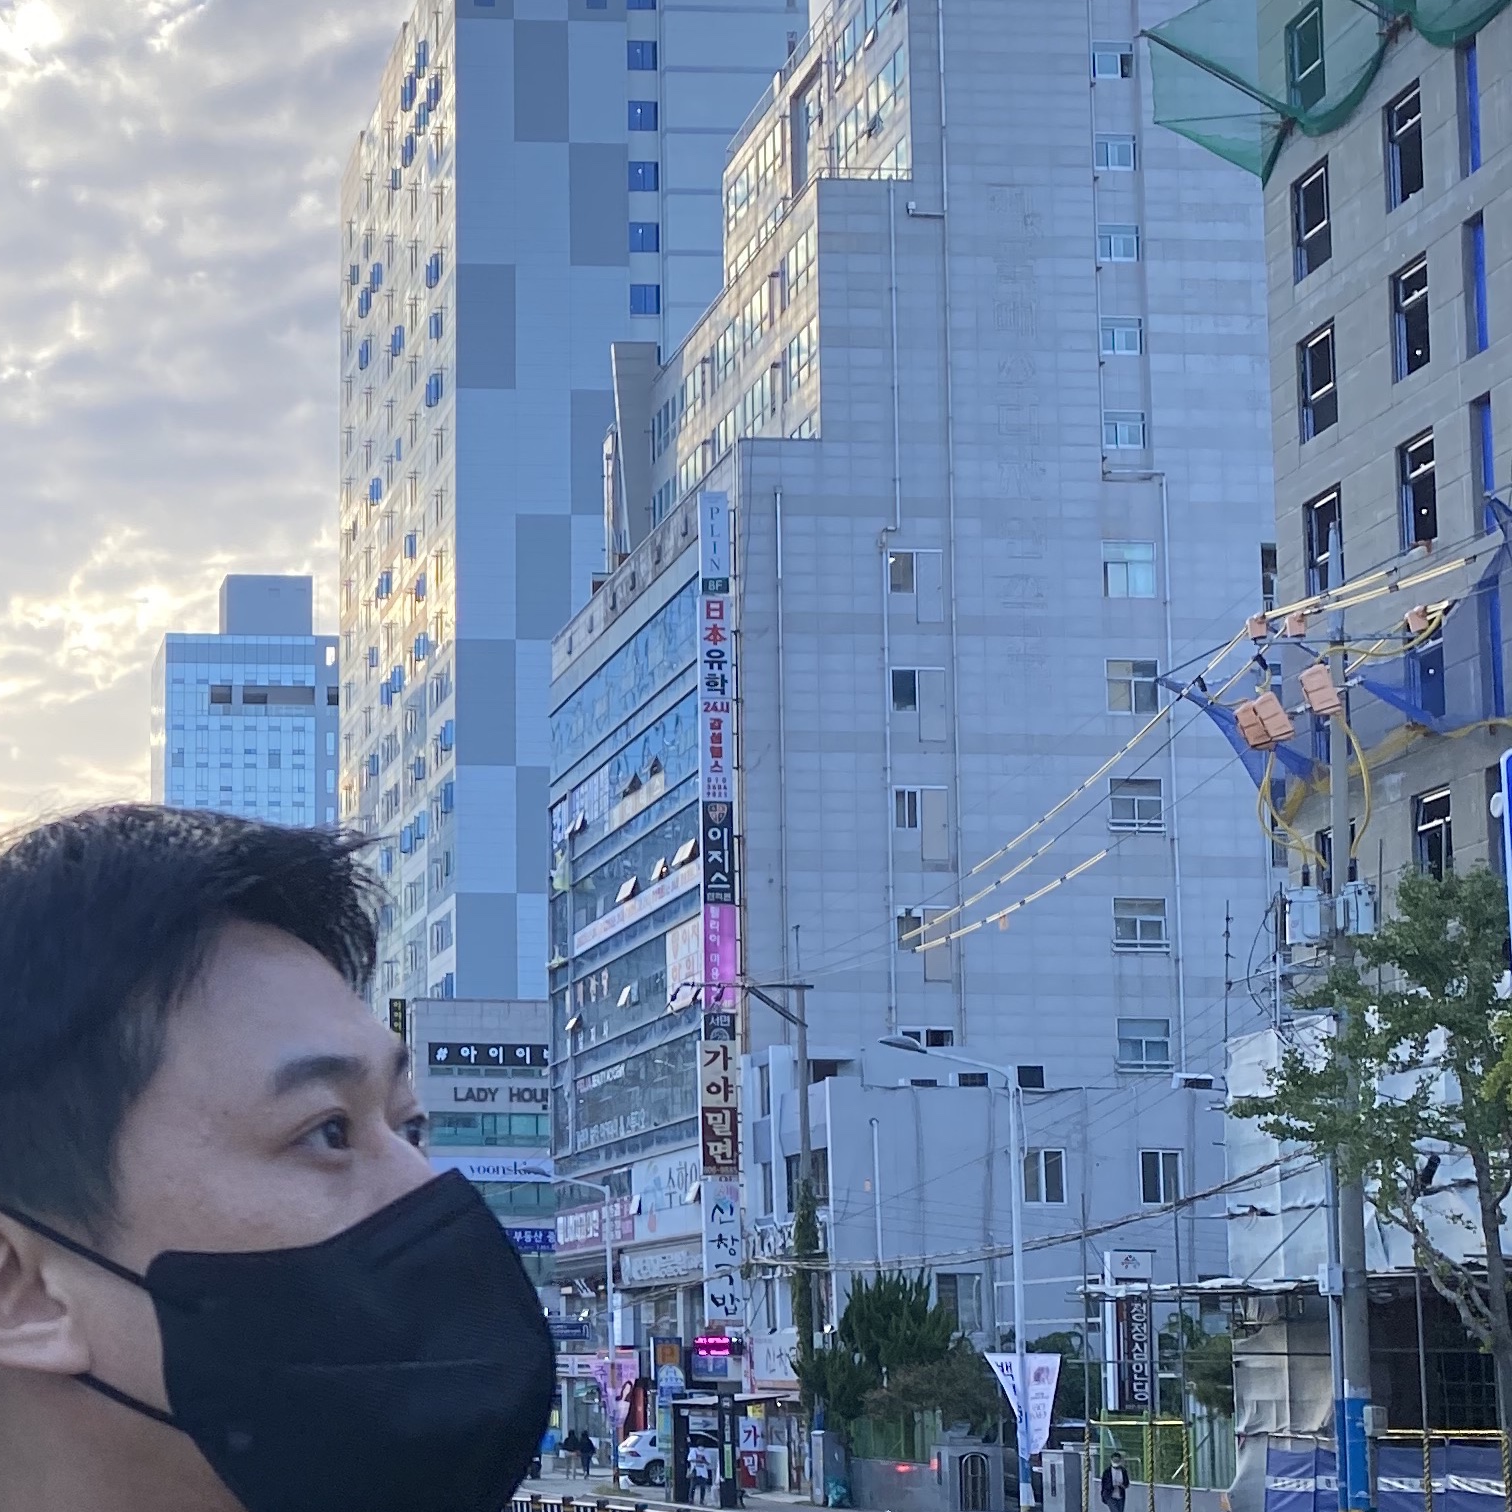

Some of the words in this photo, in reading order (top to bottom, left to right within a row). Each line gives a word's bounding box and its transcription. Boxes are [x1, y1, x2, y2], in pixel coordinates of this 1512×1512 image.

[709, 506, 720, 571] PLIN
[703, 600, 729, 695] 日本유학
[707, 827, 731, 889] 이지스
[709, 1015, 730, 1027] 서면
[453, 1086, 499, 1103] LADY
[703, 1044, 734, 1166] 가야밀면
